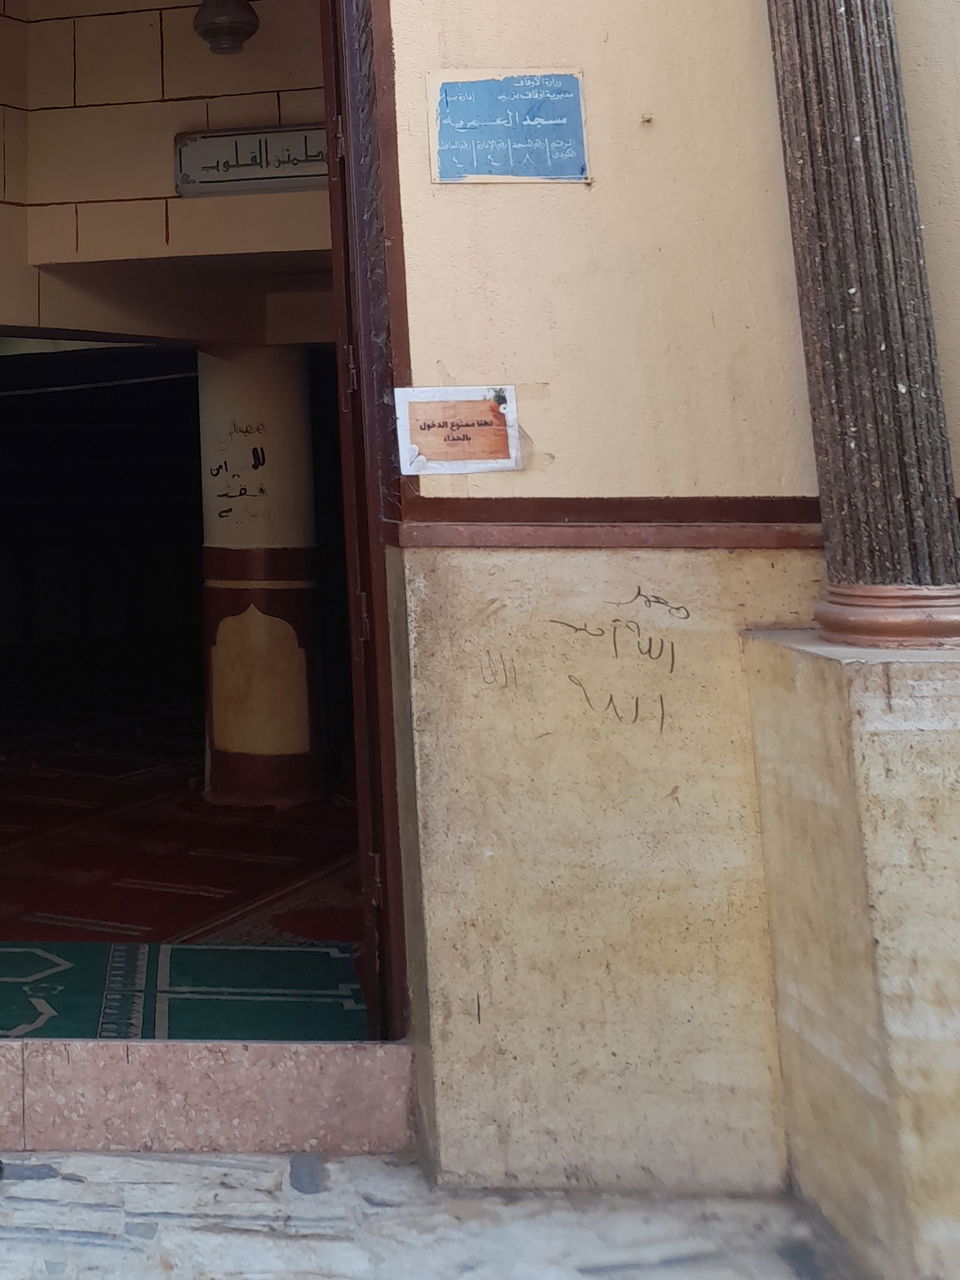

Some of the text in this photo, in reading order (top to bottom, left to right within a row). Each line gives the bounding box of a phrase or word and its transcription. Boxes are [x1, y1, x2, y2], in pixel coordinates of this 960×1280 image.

[522, 115, 567, 127] مسجد
[201, 138, 269, 172] القلوب
[420, 420, 448, 431] الدخول
[450, 421, 475, 431] ممنوع
[444, 433, 471, 444] بالحذاء
